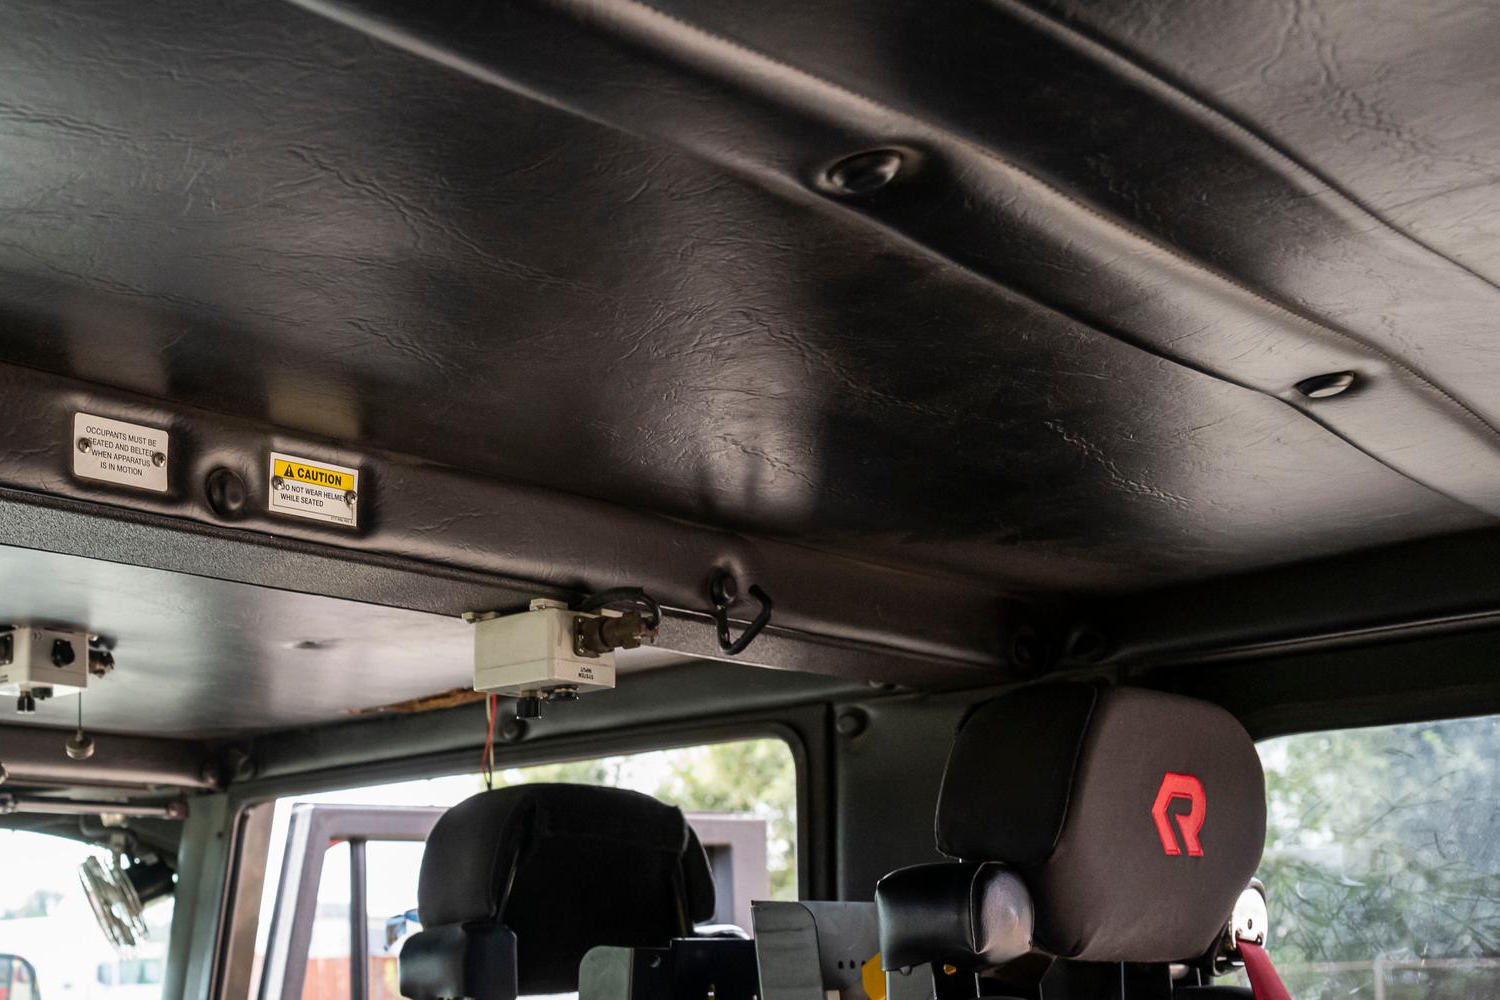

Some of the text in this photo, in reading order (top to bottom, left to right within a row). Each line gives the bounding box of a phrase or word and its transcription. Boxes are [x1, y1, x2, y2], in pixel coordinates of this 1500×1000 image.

[85, 425, 157, 447] OCCUPANTS MUST BE
[88, 437, 155, 458] SEATED AND BELTED
[91, 448, 151, 467] WHEN APPARATUS
[100, 461, 107, 469] IS
[116, 465, 143, 476] MOTION
[297, 468, 342, 486] CAUTION
[280, 492, 324, 507] WHILE SEATED
[291, 485, 304, 494] NOT
[304, 488, 322, 496] WEAR
